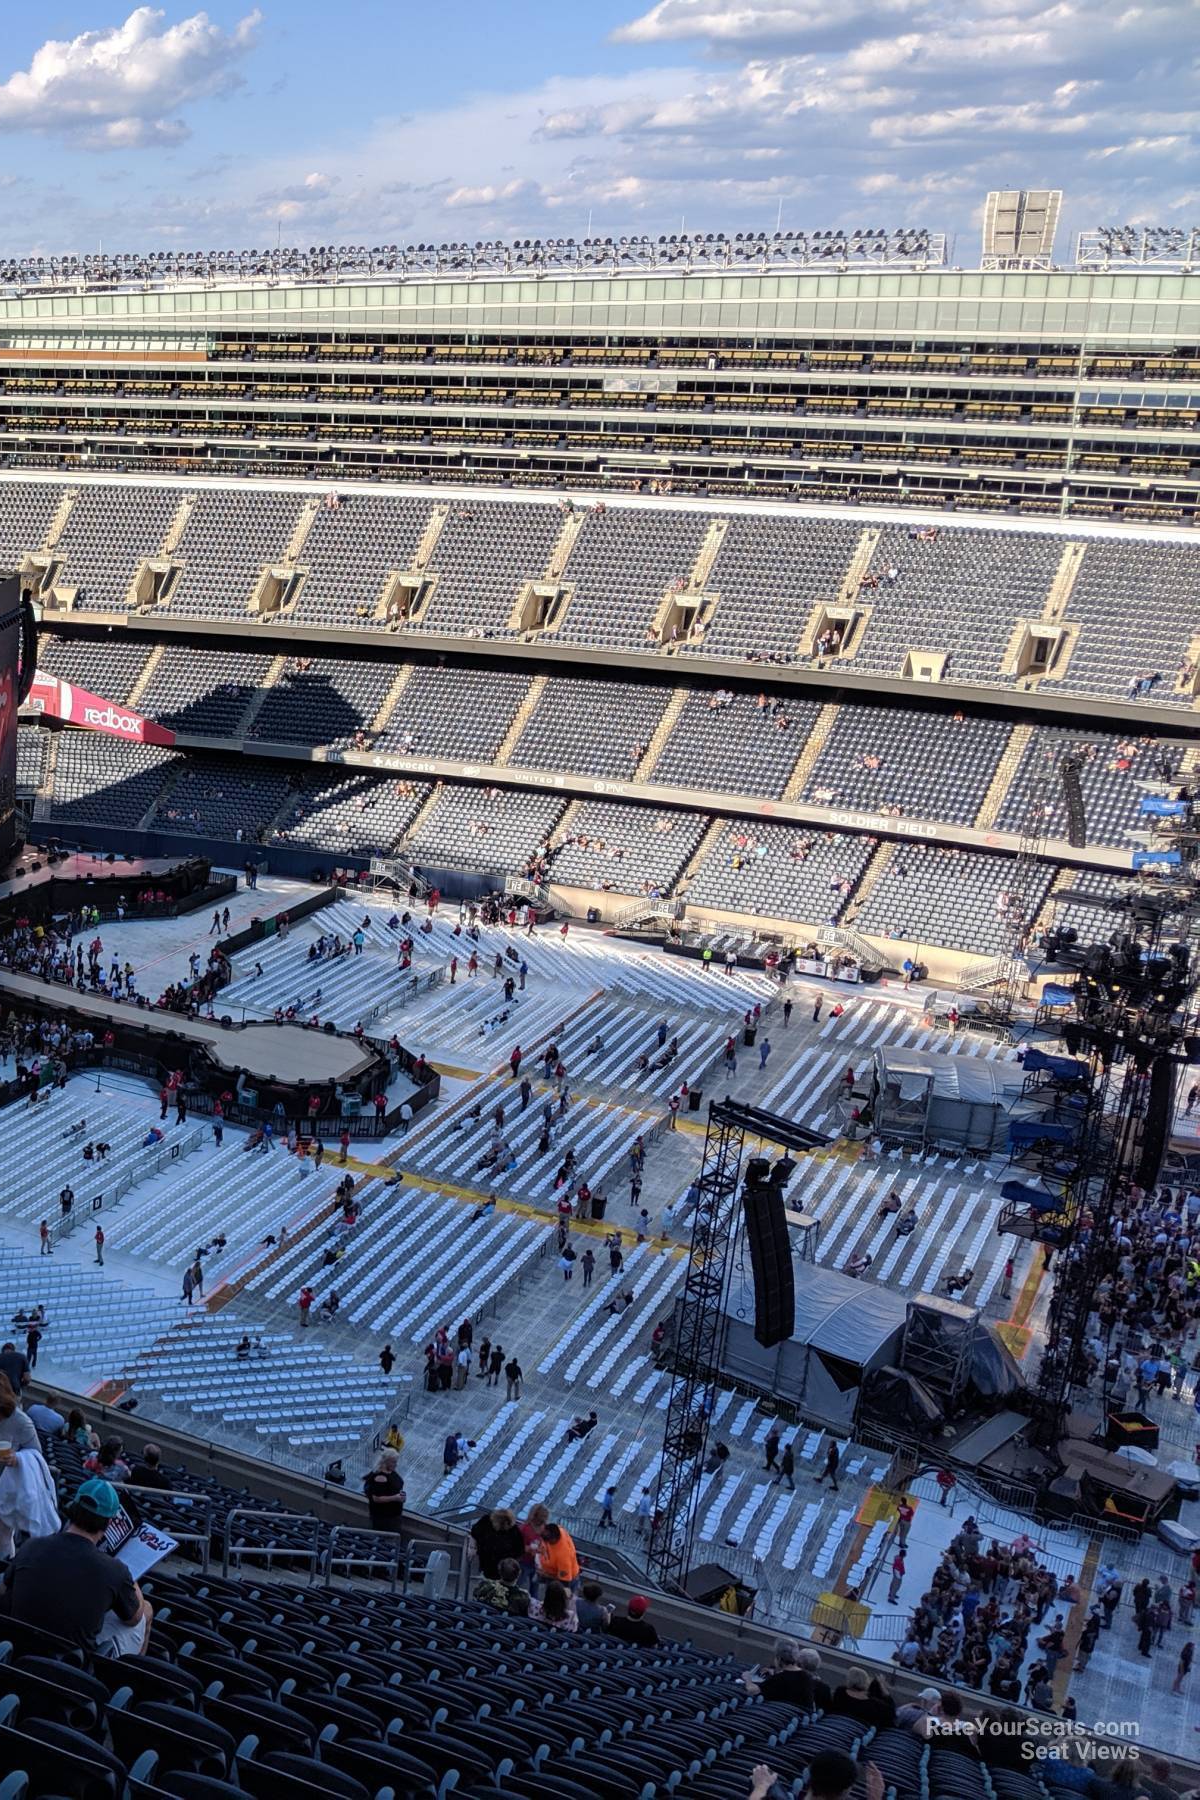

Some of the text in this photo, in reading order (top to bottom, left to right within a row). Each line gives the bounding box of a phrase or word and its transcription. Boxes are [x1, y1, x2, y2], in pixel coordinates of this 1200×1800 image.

[84, 706, 142, 734] redbox
[384, 759, 436, 772] Advocate
[829, 812, 937, 836] SOLDIER FIELD
